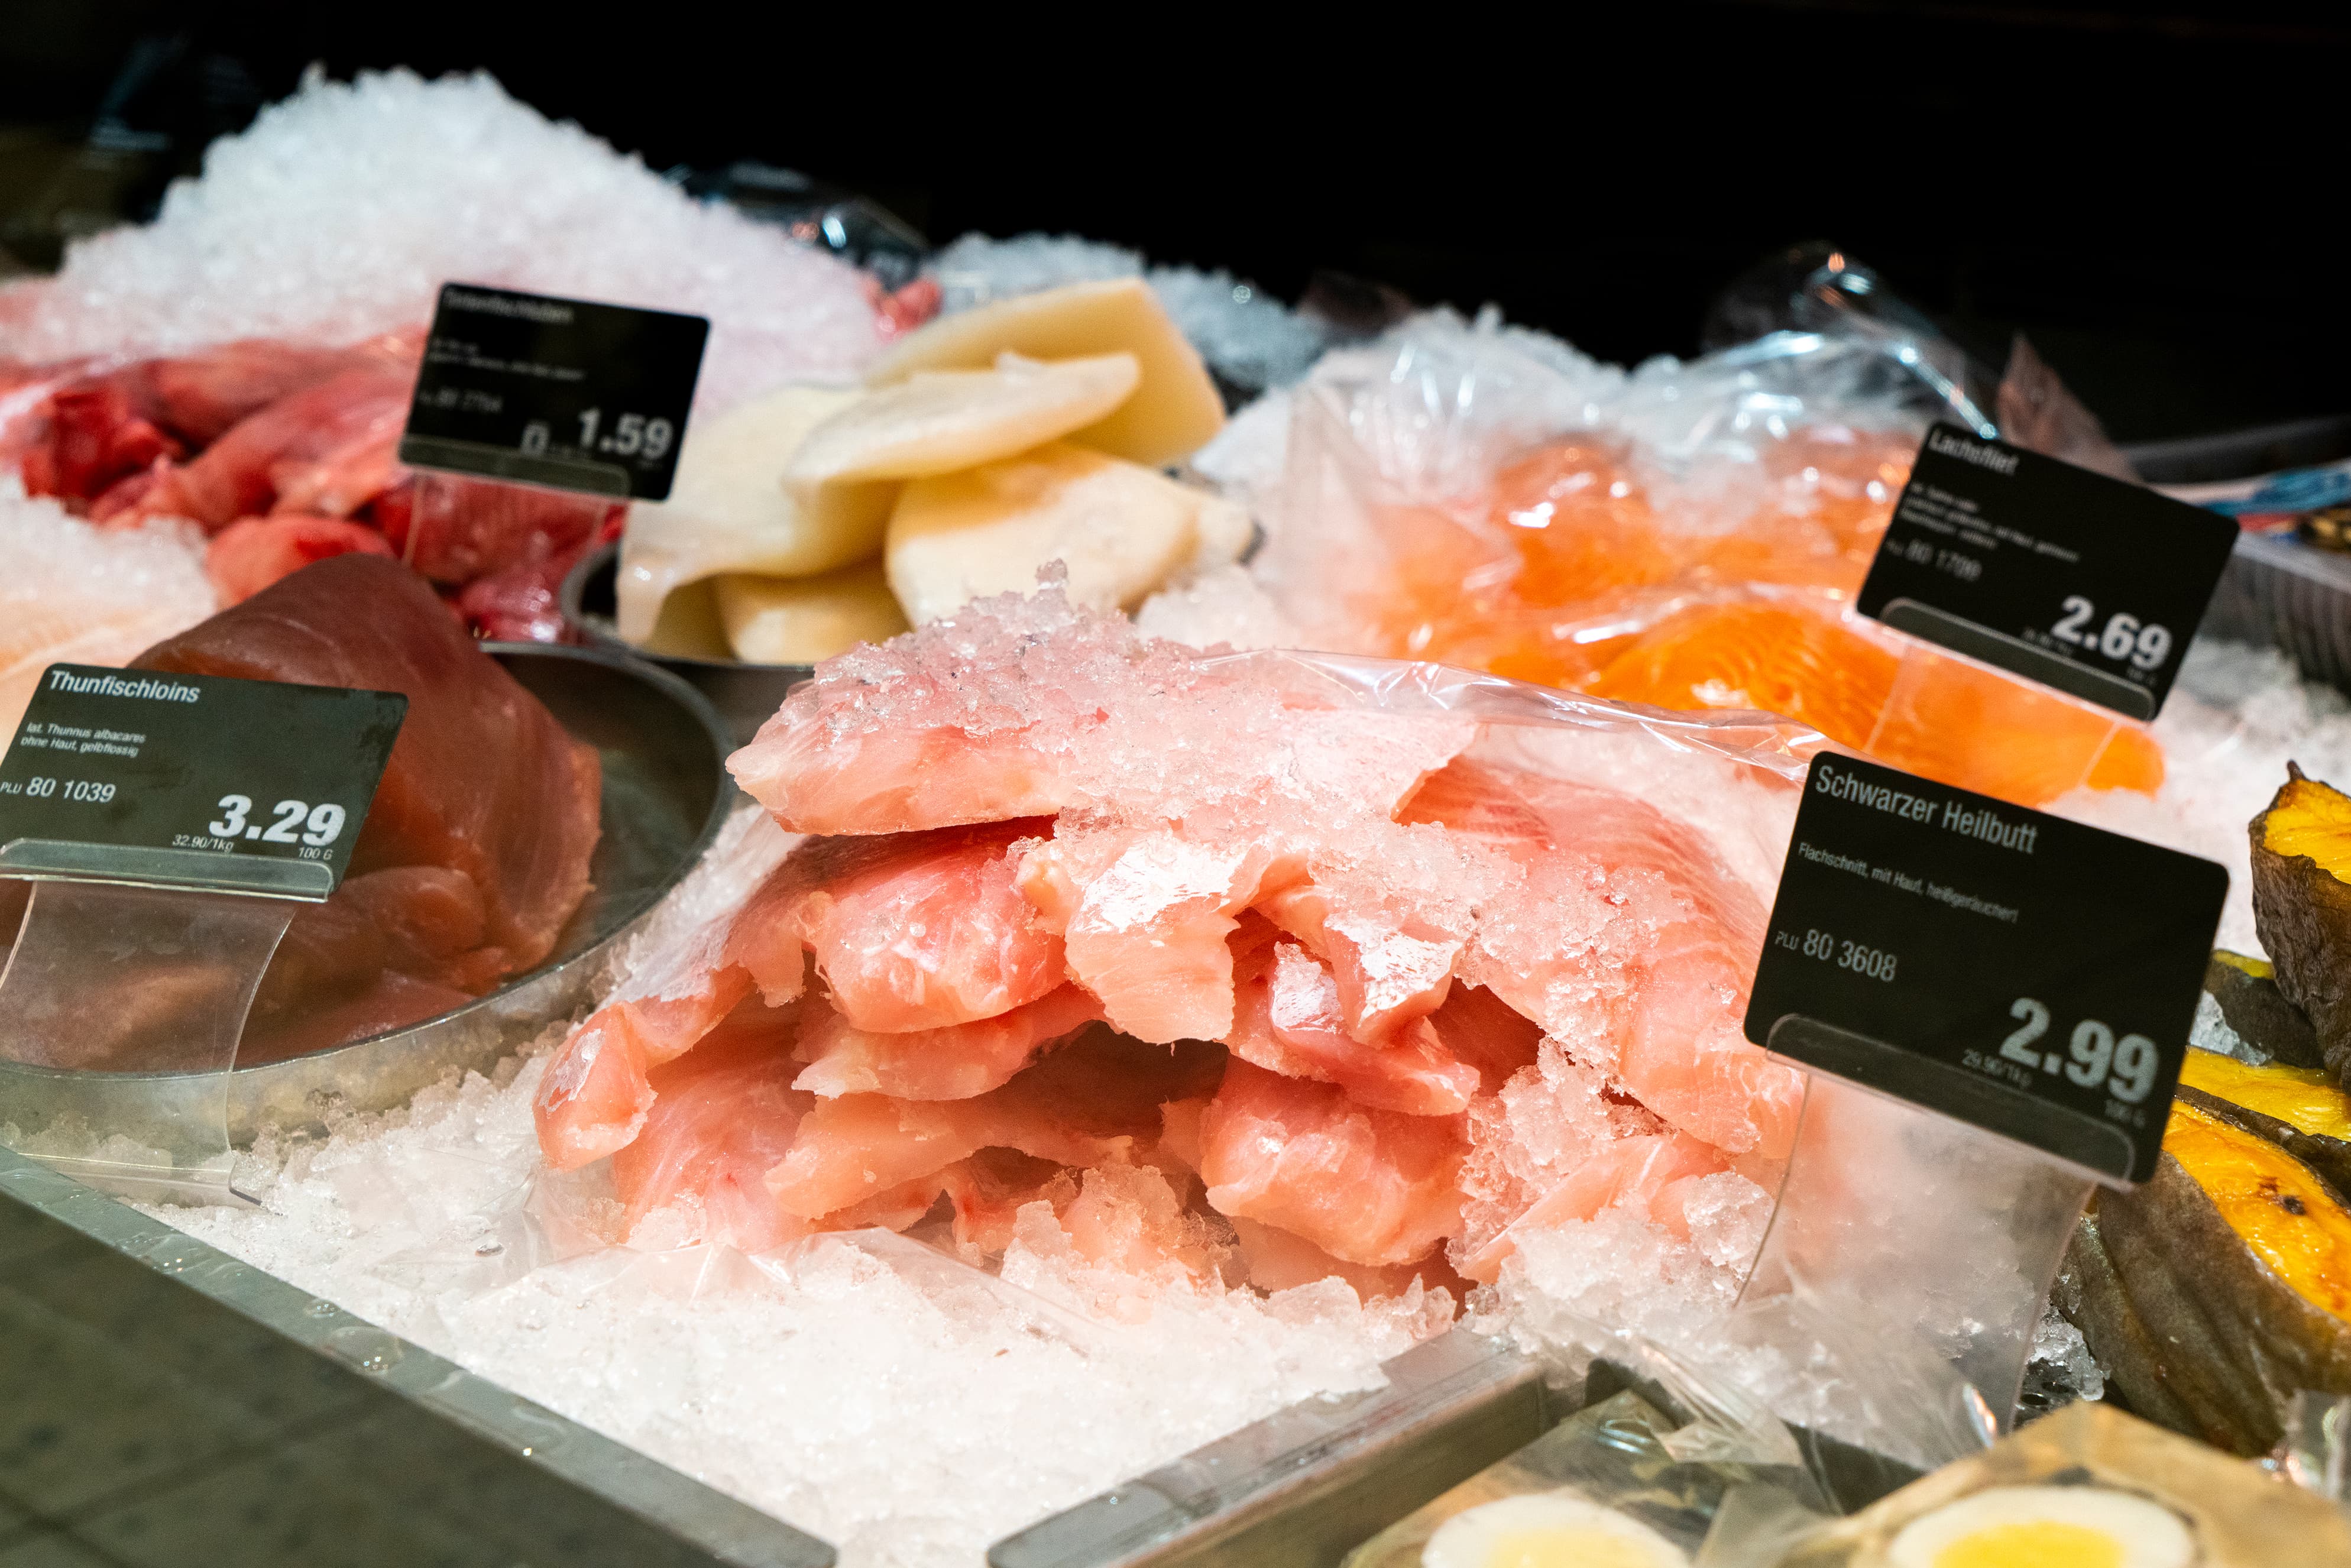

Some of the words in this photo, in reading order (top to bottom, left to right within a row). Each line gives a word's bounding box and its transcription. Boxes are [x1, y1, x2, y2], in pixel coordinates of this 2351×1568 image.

[578, 407, 673, 460] 1.59
[2051, 594, 2172, 670] 2.69
[50, 670, 200, 703] Thunfischloins
[21, 736, 48, 747] ohne
[50, 737, 77, 752] Haut,
[79, 742, 140, 759] gelbflossig
[48, 723, 92, 738] Thunnus
[93, 728, 147, 744] albacares
[0, 781, 22, 795] PLU
[26, 776, 57, 798] 80
[63, 780, 116, 803] 1039
[1815, 764, 1939, 825] Schwarzer
[1941, 799, 2038, 856] Heilbutt
[172, 834, 234, 853] 32.90/1kg
[209, 794, 346, 846] 3.29
[299, 846, 320, 860] 100
[323, 848, 333, 861] G
[1798, 841, 1869, 880] Flachschnitt,
[1871, 864, 1892, 885] mit
[1893, 870, 1923, 897] Haut,
[1774, 930, 1799, 951] PLU
[1802, 928, 1834, 961] 80
[1837, 939, 1897, 983] 3608
[1999, 997, 2158, 1104] 2.99
